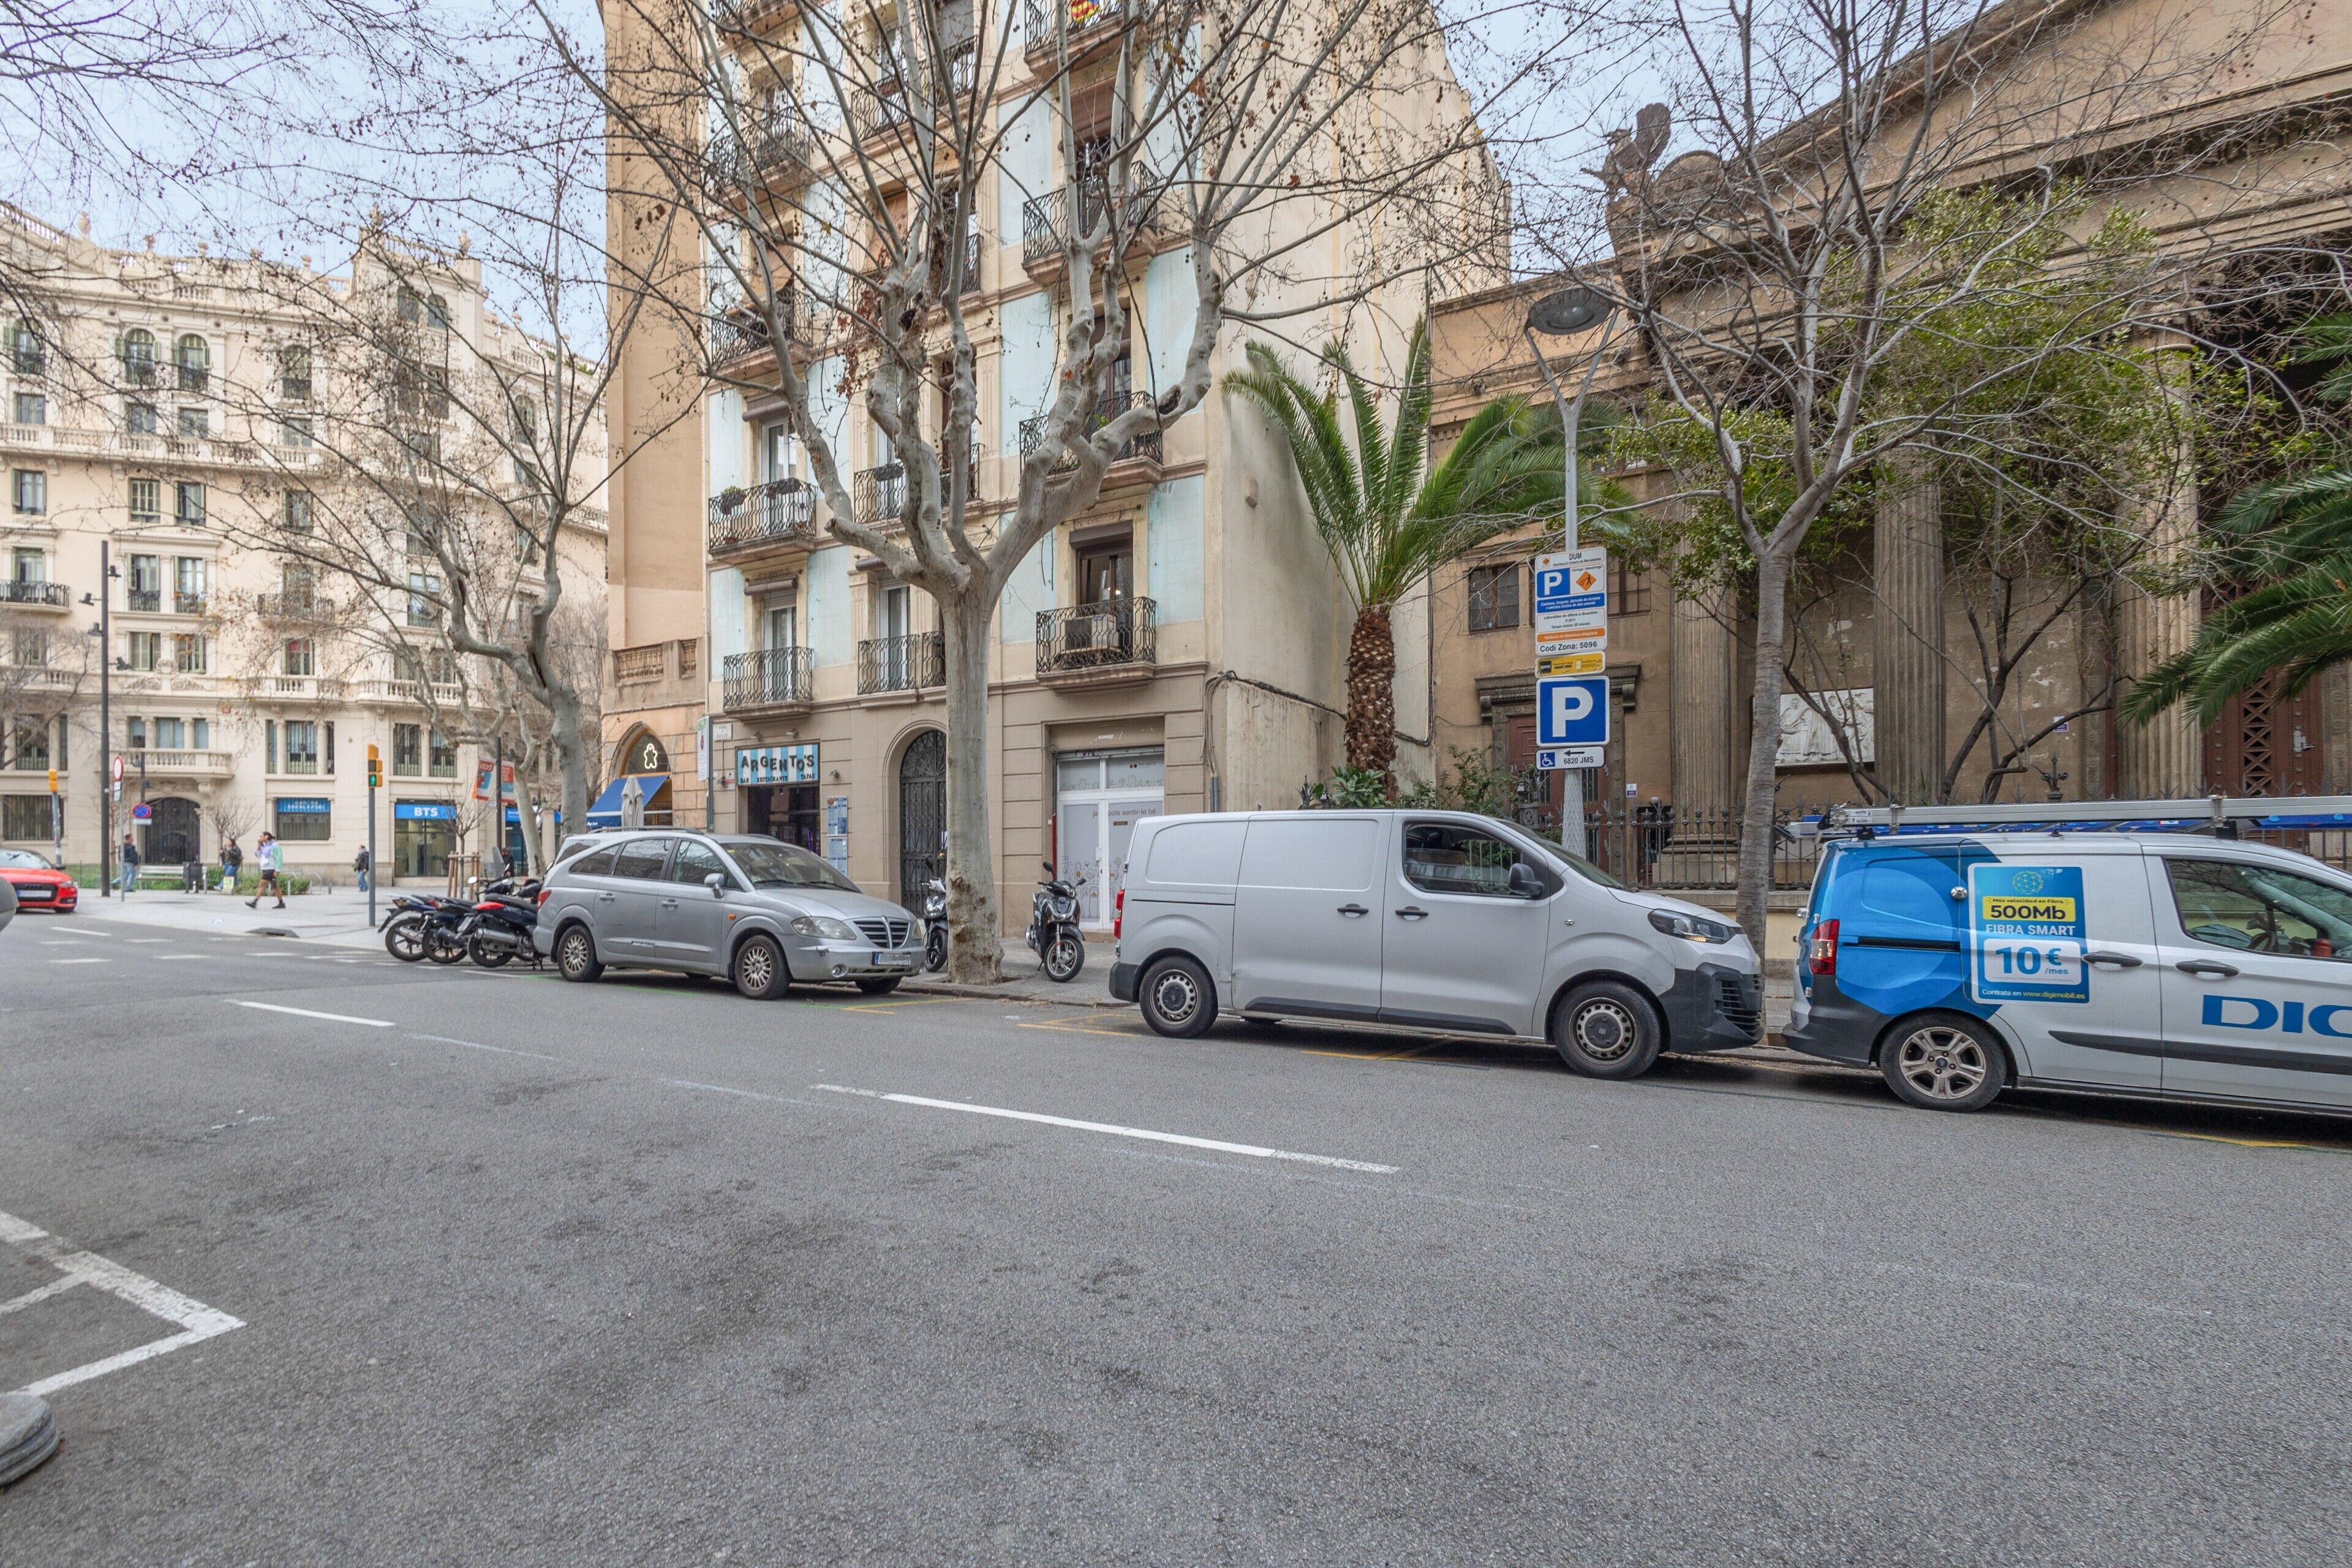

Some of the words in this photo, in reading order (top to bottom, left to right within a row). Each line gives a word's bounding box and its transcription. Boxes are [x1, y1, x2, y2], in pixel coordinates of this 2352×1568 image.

[1545, 572, 1562, 595] P
[1552, 687, 1593, 737] P
[741, 755, 814, 772] ARGENTO'S
[414, 807, 438, 816] BTS
[1991, 905, 2066, 920] 500Mb
[1986, 924, 2024, 935] FIBRA
[2028, 925, 2076, 936] SMART
[1996, 946, 2041, 974] 10
[2046, 948, 2062, 966] €
[2022, 991, 2085, 1000] www.digimobil.es
